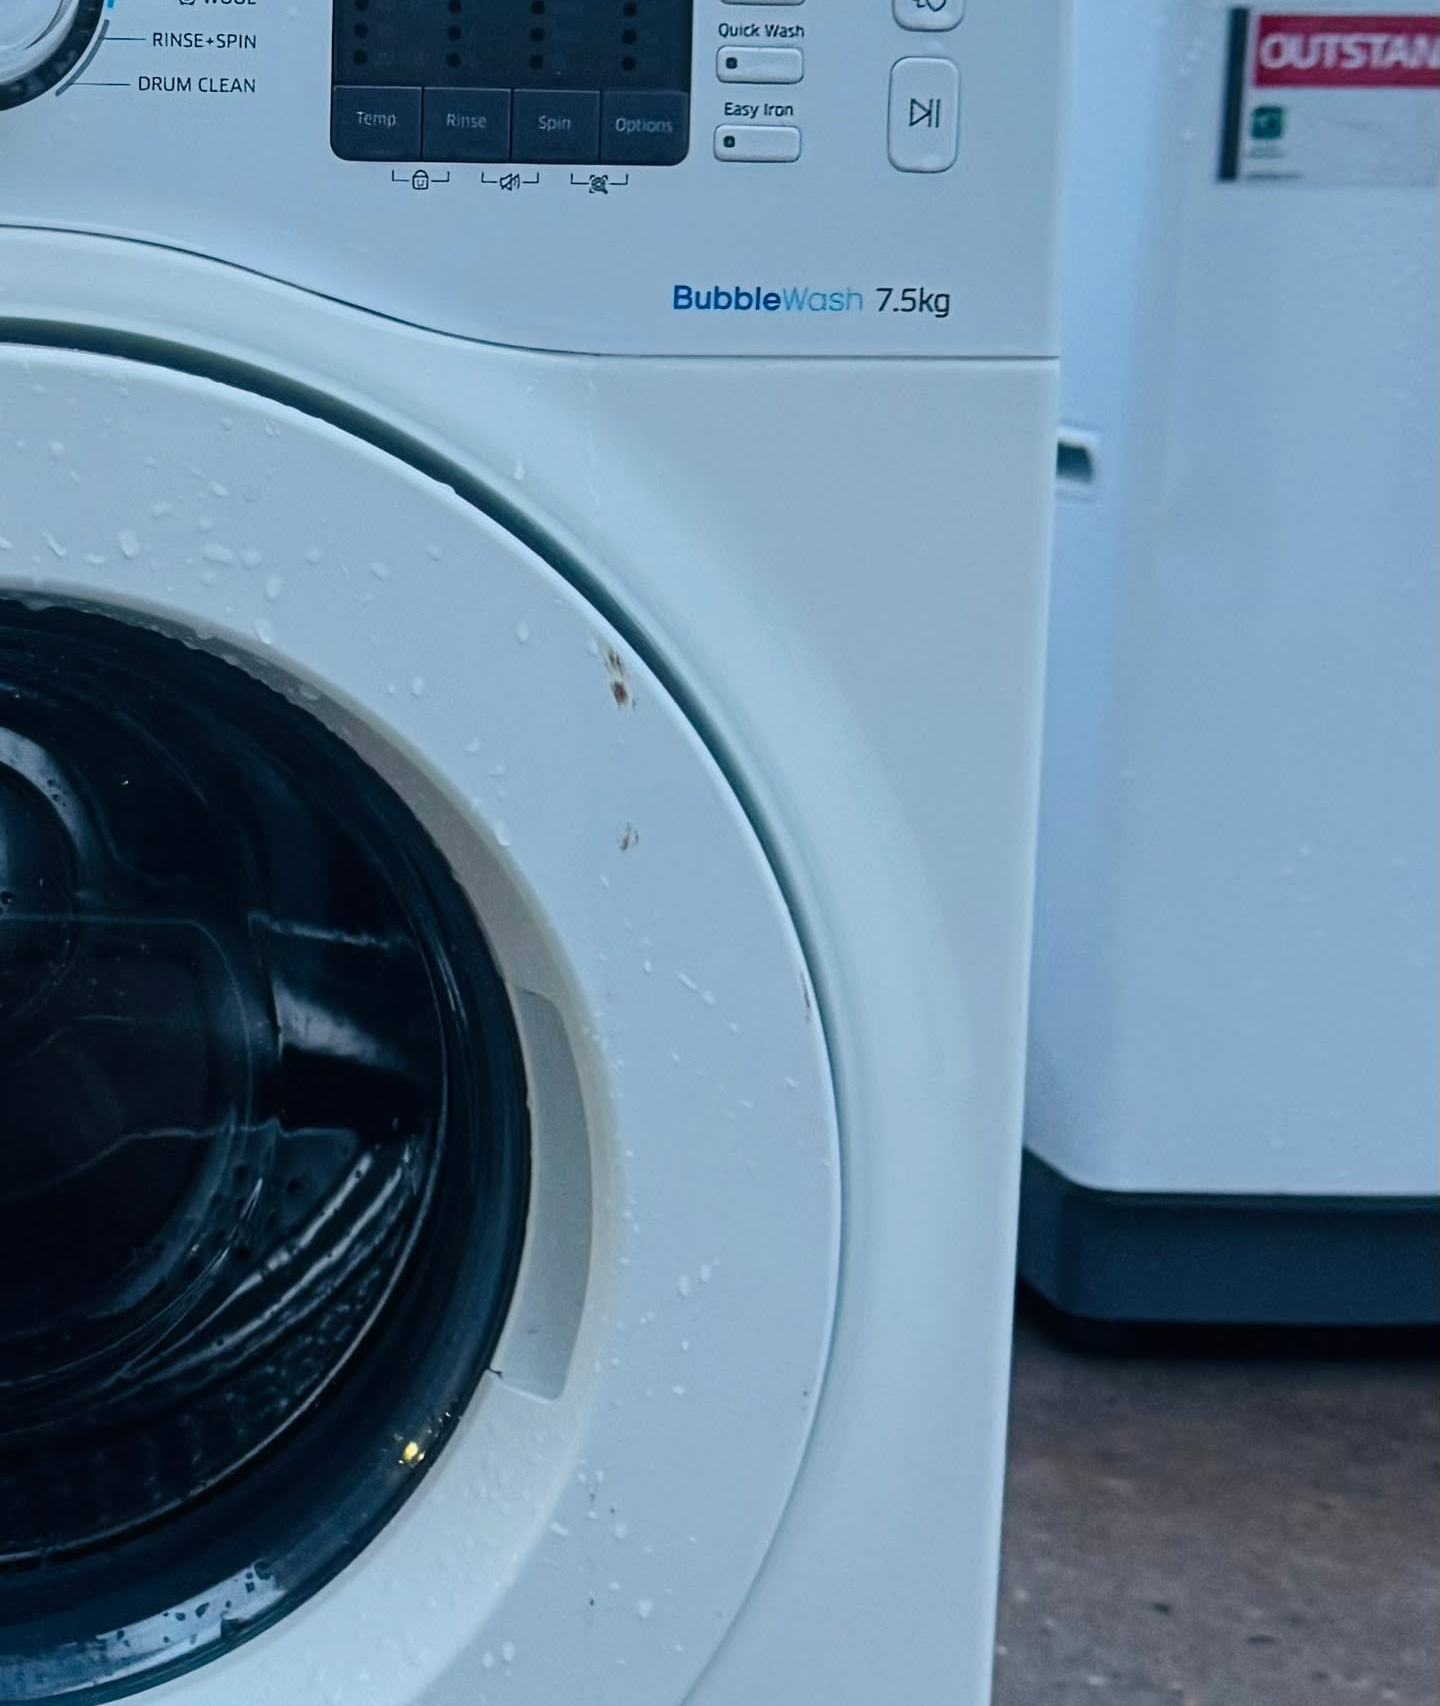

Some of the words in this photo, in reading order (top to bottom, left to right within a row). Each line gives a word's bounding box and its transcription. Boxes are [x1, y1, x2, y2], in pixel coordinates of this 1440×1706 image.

[718, 22, 761, 39] Quick
[765, 24, 805, 38] Wash
[151, 31, 257, 50] RINSE+SPIN
[138, 75, 192, 94] DRUM
[197, 76, 257, 95] CLEAN
[724, 102, 760, 119] Easy
[763, 103, 794, 117] Iron
[446, 112, 488, 129] Rinse
[538, 114, 572, 132] Spin
[615, 116, 674, 134] Options
[673, 285, 864, 312] BubbleWash
[875, 286, 951, 318] 7.5kg
